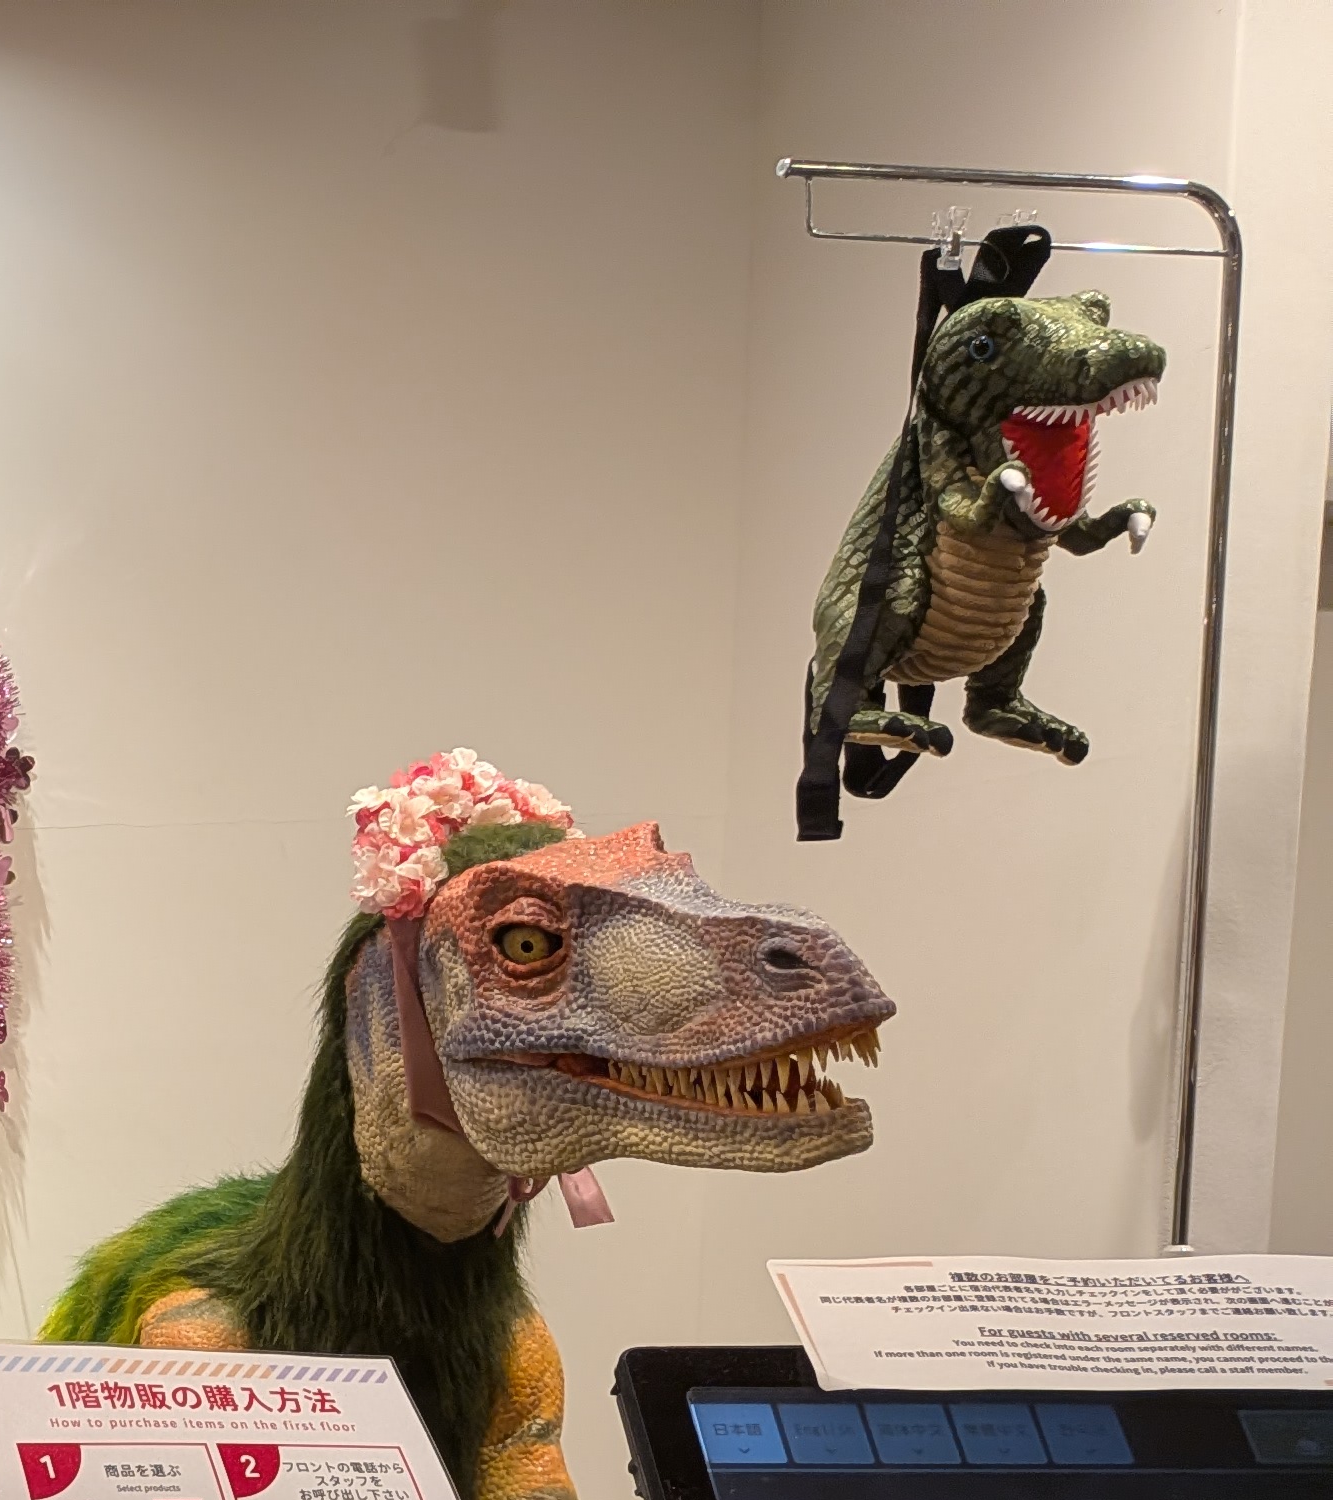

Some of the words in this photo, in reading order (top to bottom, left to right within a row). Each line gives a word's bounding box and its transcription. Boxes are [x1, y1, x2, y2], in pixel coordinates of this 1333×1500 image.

[977, 1327, 1006, 1337] For
[1004, 1329, 1058, 1340] guests
[1055, 1330, 1091, 1341] with
[1092, 1330, 1151, 1341] several
[1151, 1329, 1223, 1342] reserved
[1220, 1332, 1280, 1341] rooms:
[47, 1382, 342, 1415] 1階物販の購入方法
[49, 1418, 80, 1427] How
[87, 1418, 102, 1427] to
[109, 1417, 177, 1430] purchase
[182, 1418, 224, 1428] items
[253, 1420, 277, 1429] the
[282, 1420, 315, 1430] first
[319, 1421, 355, 1431] floor
[713, 1422, 763, 1437] 日本語
[39, 1454, 56, 1480] 1
[104, 1463, 182, 1479] 商品を選ぶ
[240, 1455, 260, 1478] 2
[283, 1462, 404, 1474] フロントの電話から
[144, 1484, 180, 1493] products
[315, 1476, 383, 1487] スタッフを
[300, 1489, 410, 1500] お呼び出し下さい
